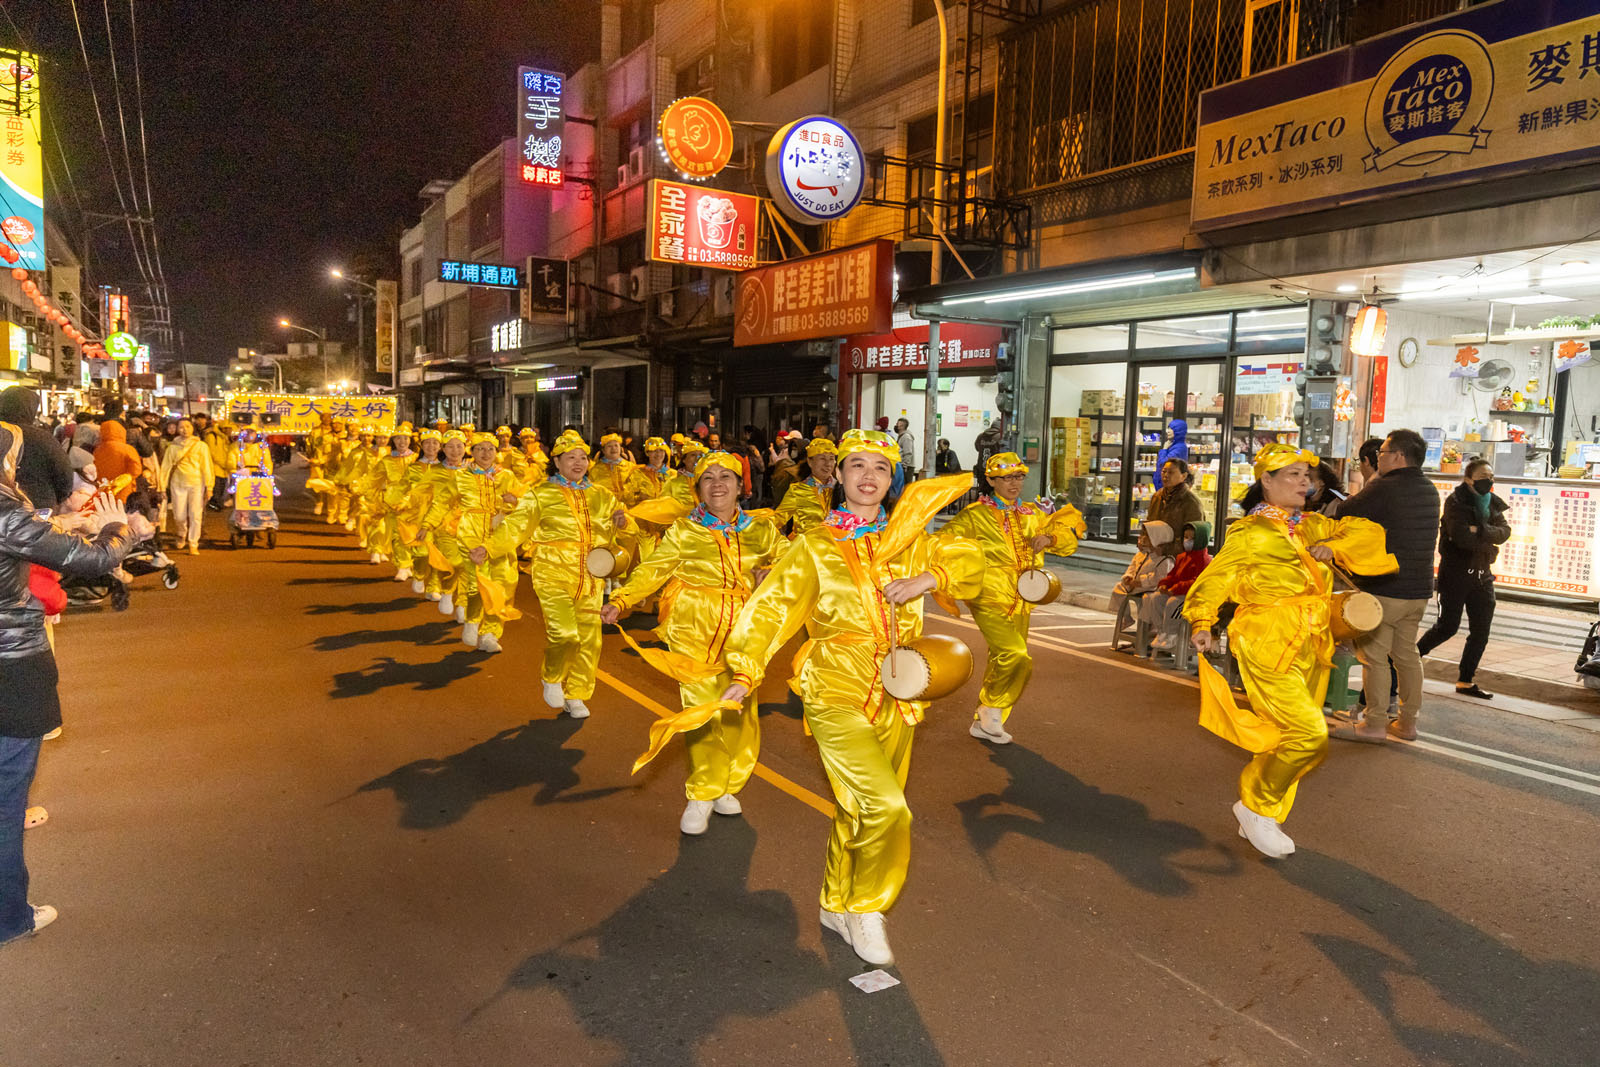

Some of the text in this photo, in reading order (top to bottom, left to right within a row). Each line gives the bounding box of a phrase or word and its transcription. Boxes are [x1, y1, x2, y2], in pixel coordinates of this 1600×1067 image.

[1411, 63, 1465, 90] Mex
[1385, 80, 1464, 116] Taco
[1388, 100, 1467, 134] 麥斯塔客
[799, 129, 844, 148] 進口食品
[1208, 116, 1346, 169] MexTaco
[794, 192, 845, 212] JUST DO EAT
[659, 186, 687, 261] 全家餐
[441, 261, 518, 286] 新埔通訊
[773, 250, 871, 313] 胖老爹美式炸雞
[801, 305, 869, 330] 03-5889569
[232, 399, 390, 420] 法輪大法好
[244, 482, 267, 507] 善
[1517, 578, 1585, 593] 03-5892325
